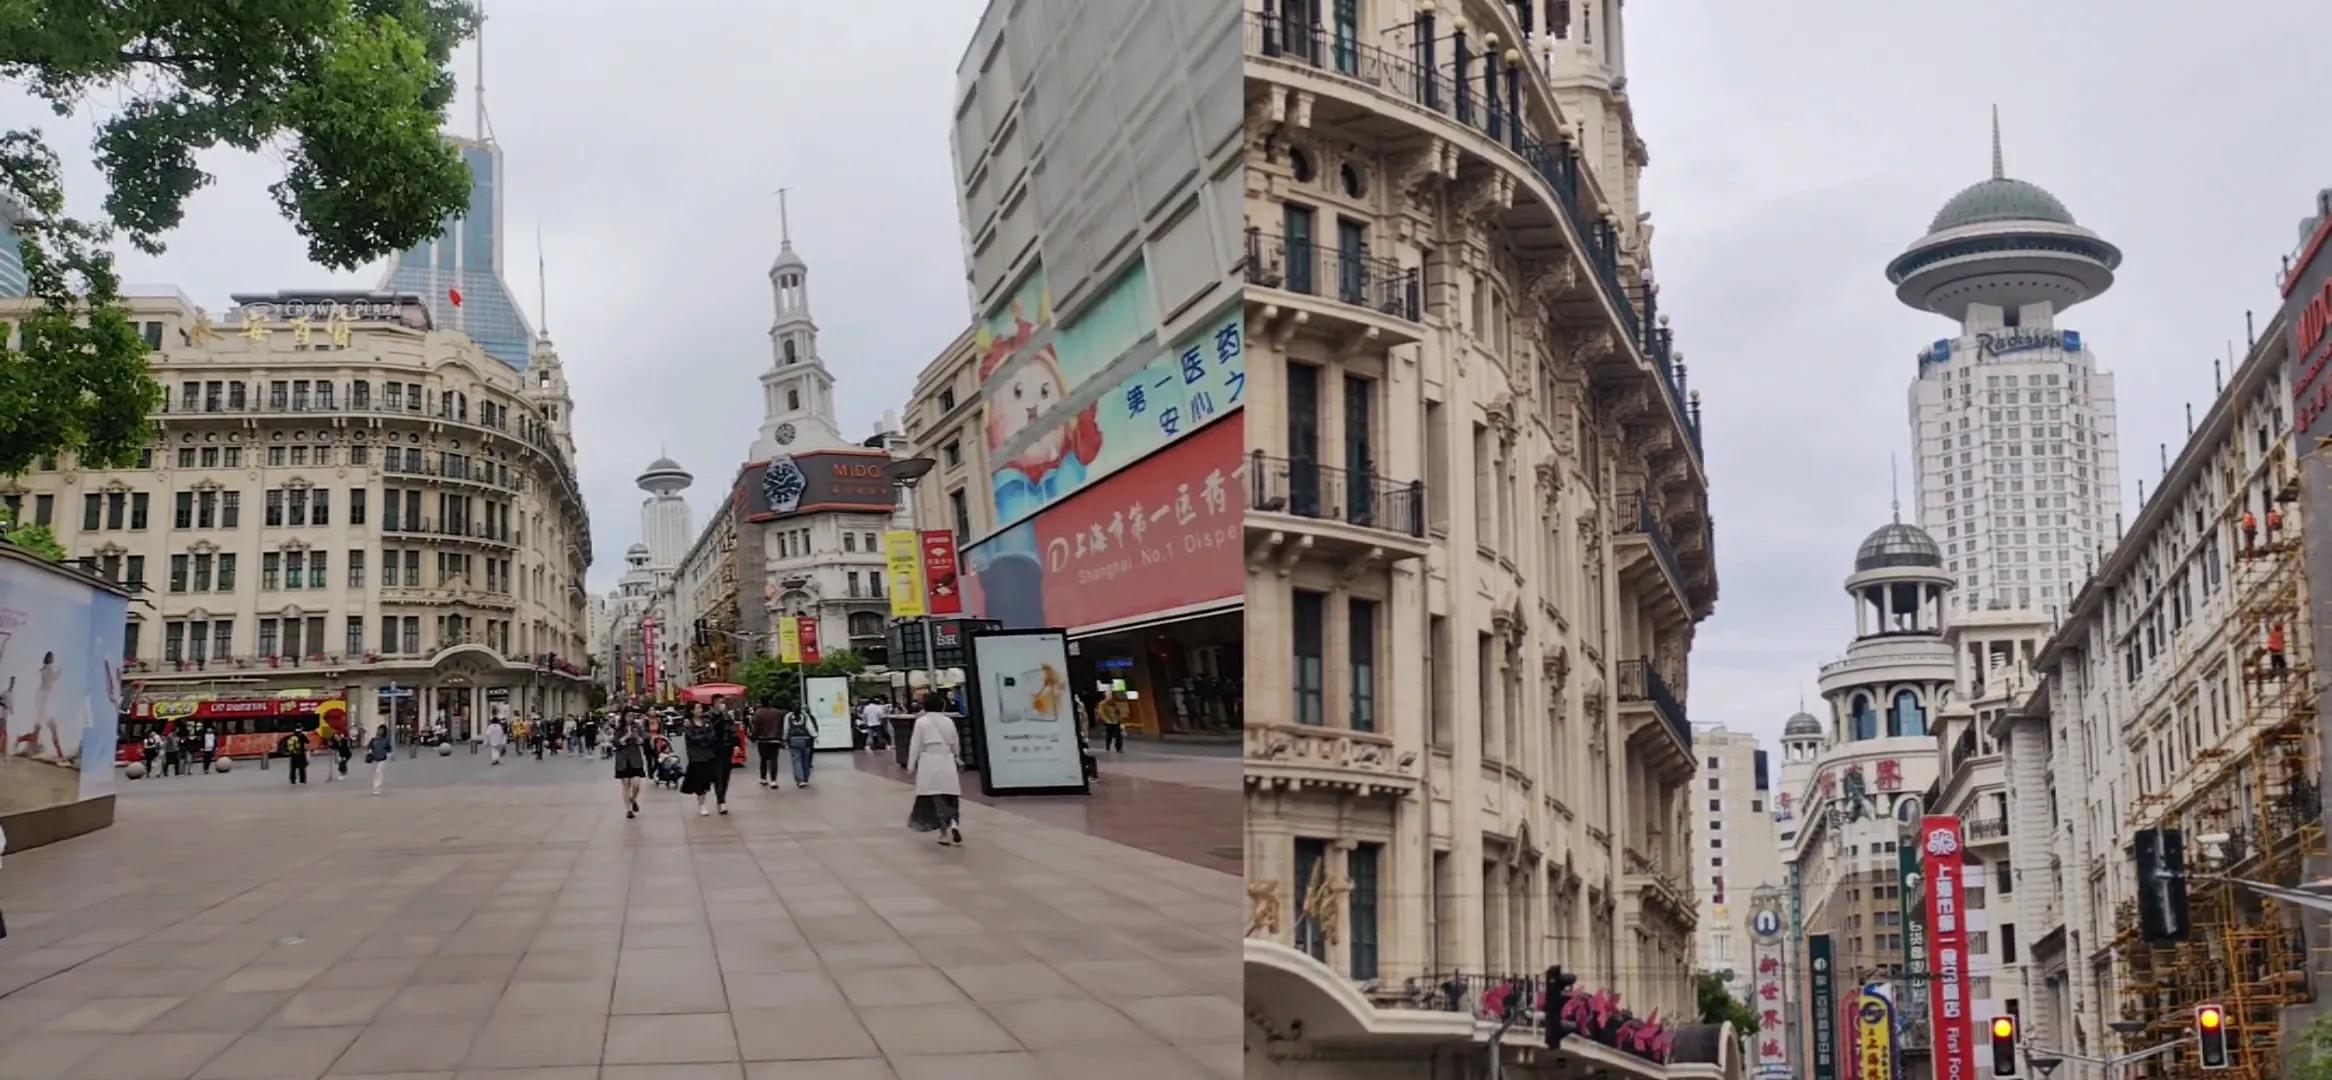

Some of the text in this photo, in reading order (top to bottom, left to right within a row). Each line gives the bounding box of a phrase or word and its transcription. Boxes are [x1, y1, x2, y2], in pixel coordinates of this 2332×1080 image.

[1126, 322, 1240, 419] 第一医药
[832, 463, 881, 478] MIDO
[1078, 556, 1133, 584] Shanghai
[1758, 953, 1783, 1058] 新世界城
